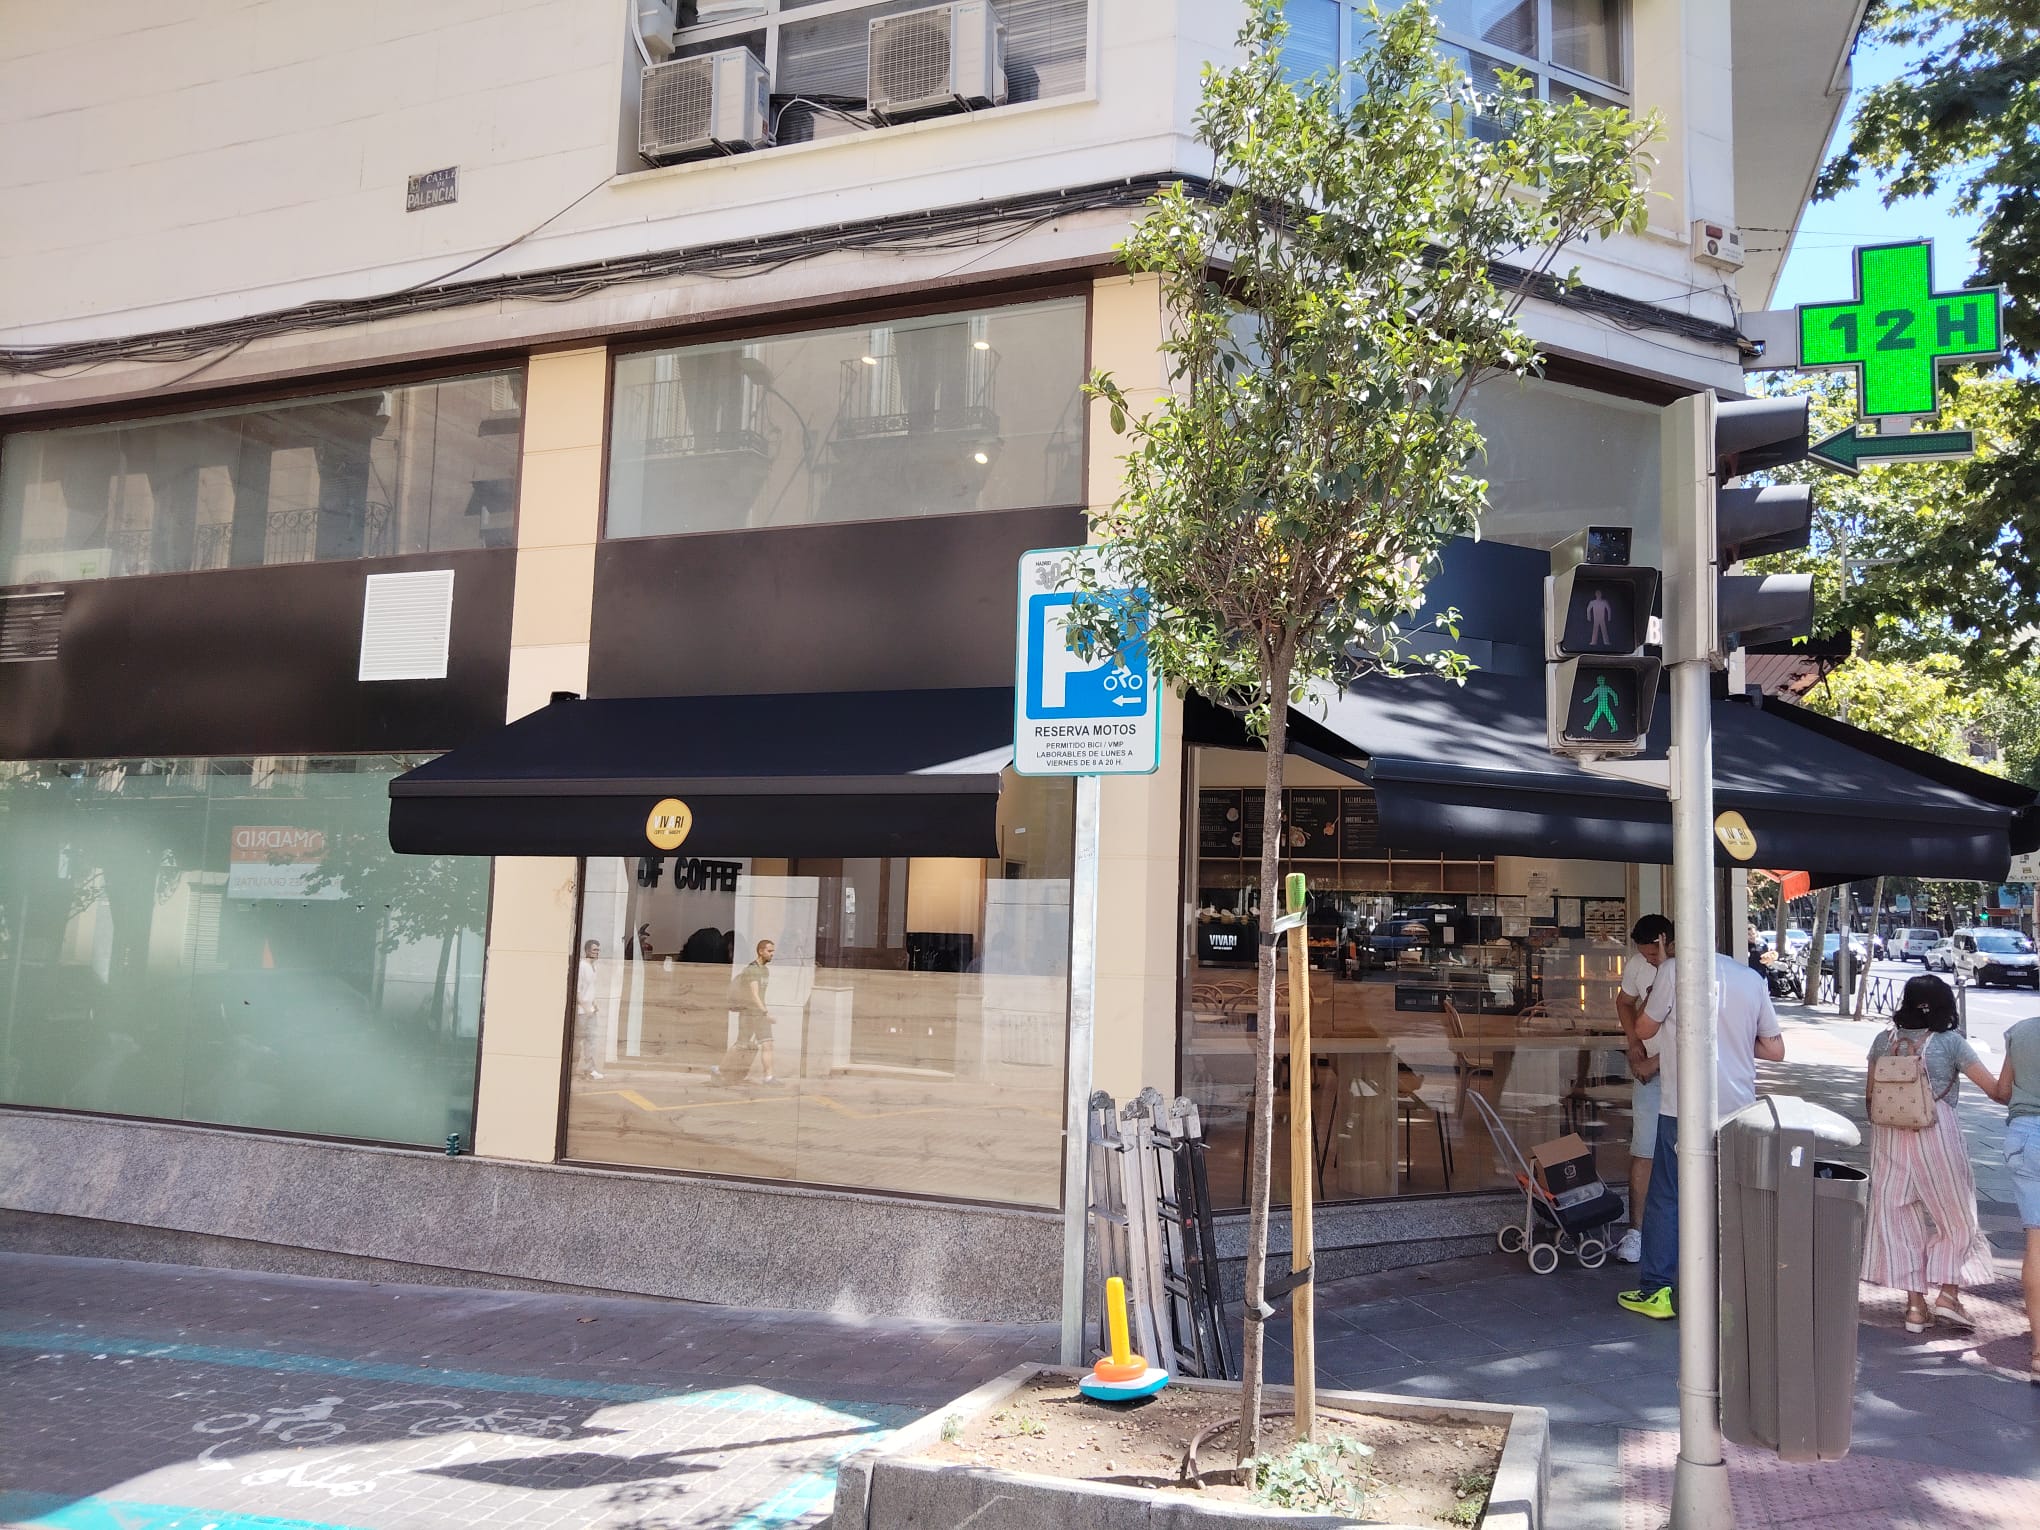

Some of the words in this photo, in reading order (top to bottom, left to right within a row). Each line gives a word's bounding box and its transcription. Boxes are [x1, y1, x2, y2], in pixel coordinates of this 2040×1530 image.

[426, 171, 456, 183] CALLE
[408, 186, 455, 208] PALENCIA
[1935, 303, 1979, 347] H
[1035, 725, 1090, 737] RESERVA
[1093, 723, 1136, 736] MOTOS
[1046, 741, 1086, 749] PERMITIDO
[637, 856, 664, 889] OF
[674, 856, 743, 892] COFFEE
[1209, 934, 1237, 946] VIVARI
